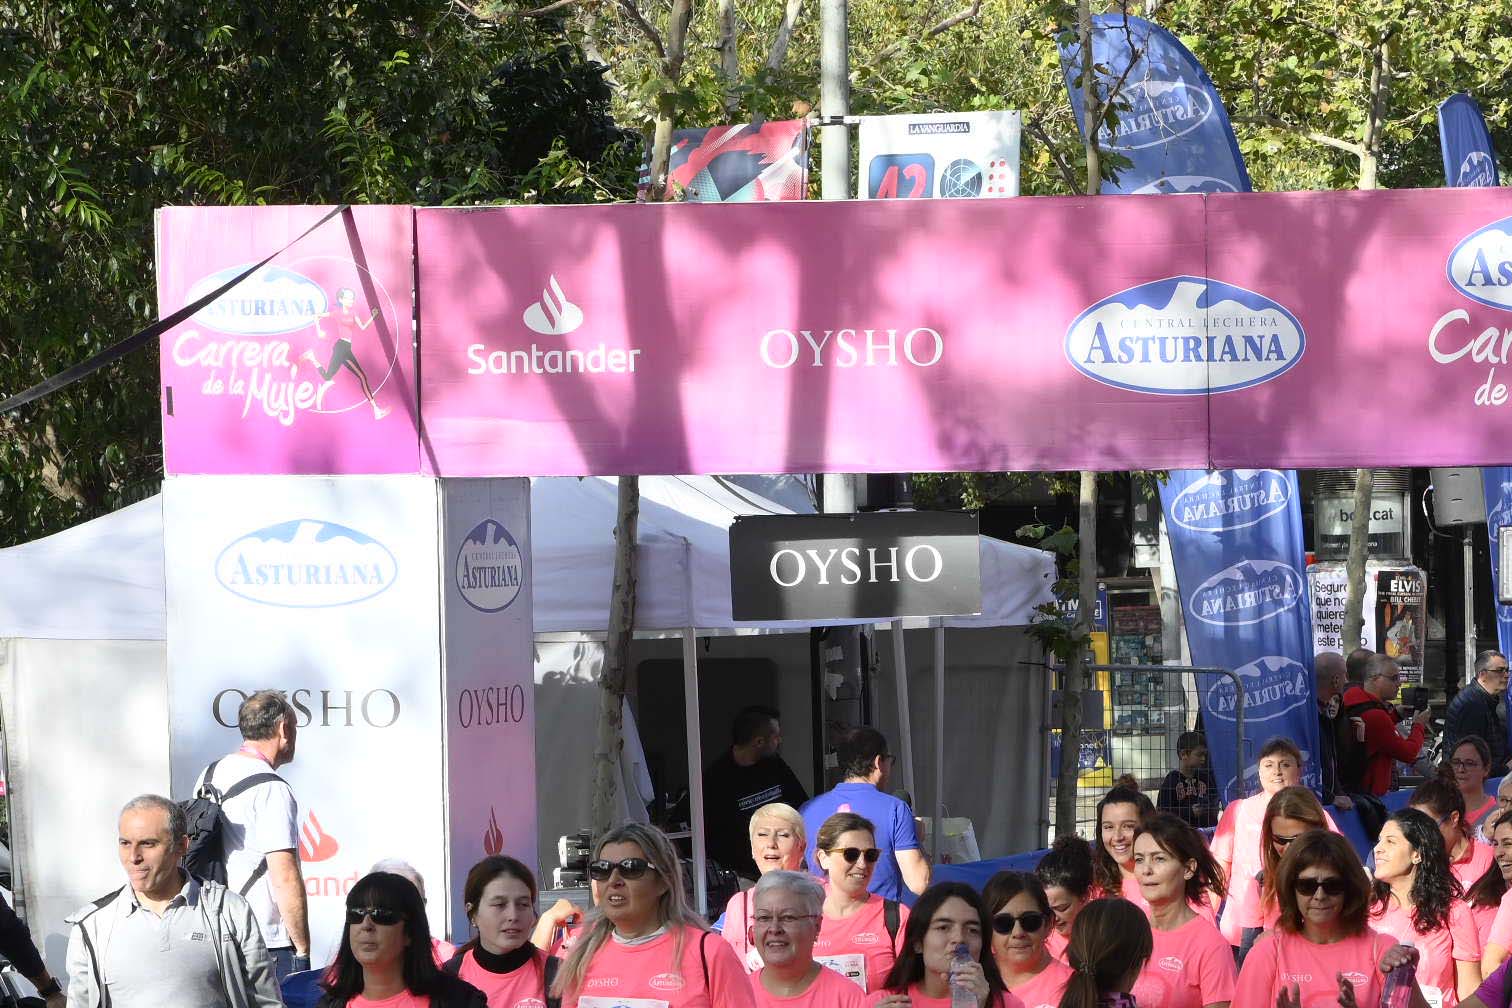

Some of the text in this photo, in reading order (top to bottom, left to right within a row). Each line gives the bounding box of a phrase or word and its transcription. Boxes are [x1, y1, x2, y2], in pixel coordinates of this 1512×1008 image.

[1119, 315, 1279, 329] CENTRAL LECHERA
[172, 330, 289, 368] Carrera
[467, 343, 640, 376] Santander
[759, 327, 944, 369] OYSHO
[1084, 321, 1286, 364] ASTURIANA
[201, 362, 333, 425] de la Mujer
[1474, 367, 1510, 406] de
[230, 552, 385, 586] ASTURIANA
[462, 557, 520, 590] ASTURIANA
[769, 544, 943, 587] OYSHO
[1315, 598, 1332, 608] que
[1390, 579, 1422, 593] ELVIS
[1316, 610, 1346, 622] quiere
[1317, 637, 1336, 647] este
[212, 688, 402, 729] OSHO
[458, 684, 525, 729] OYSHO
